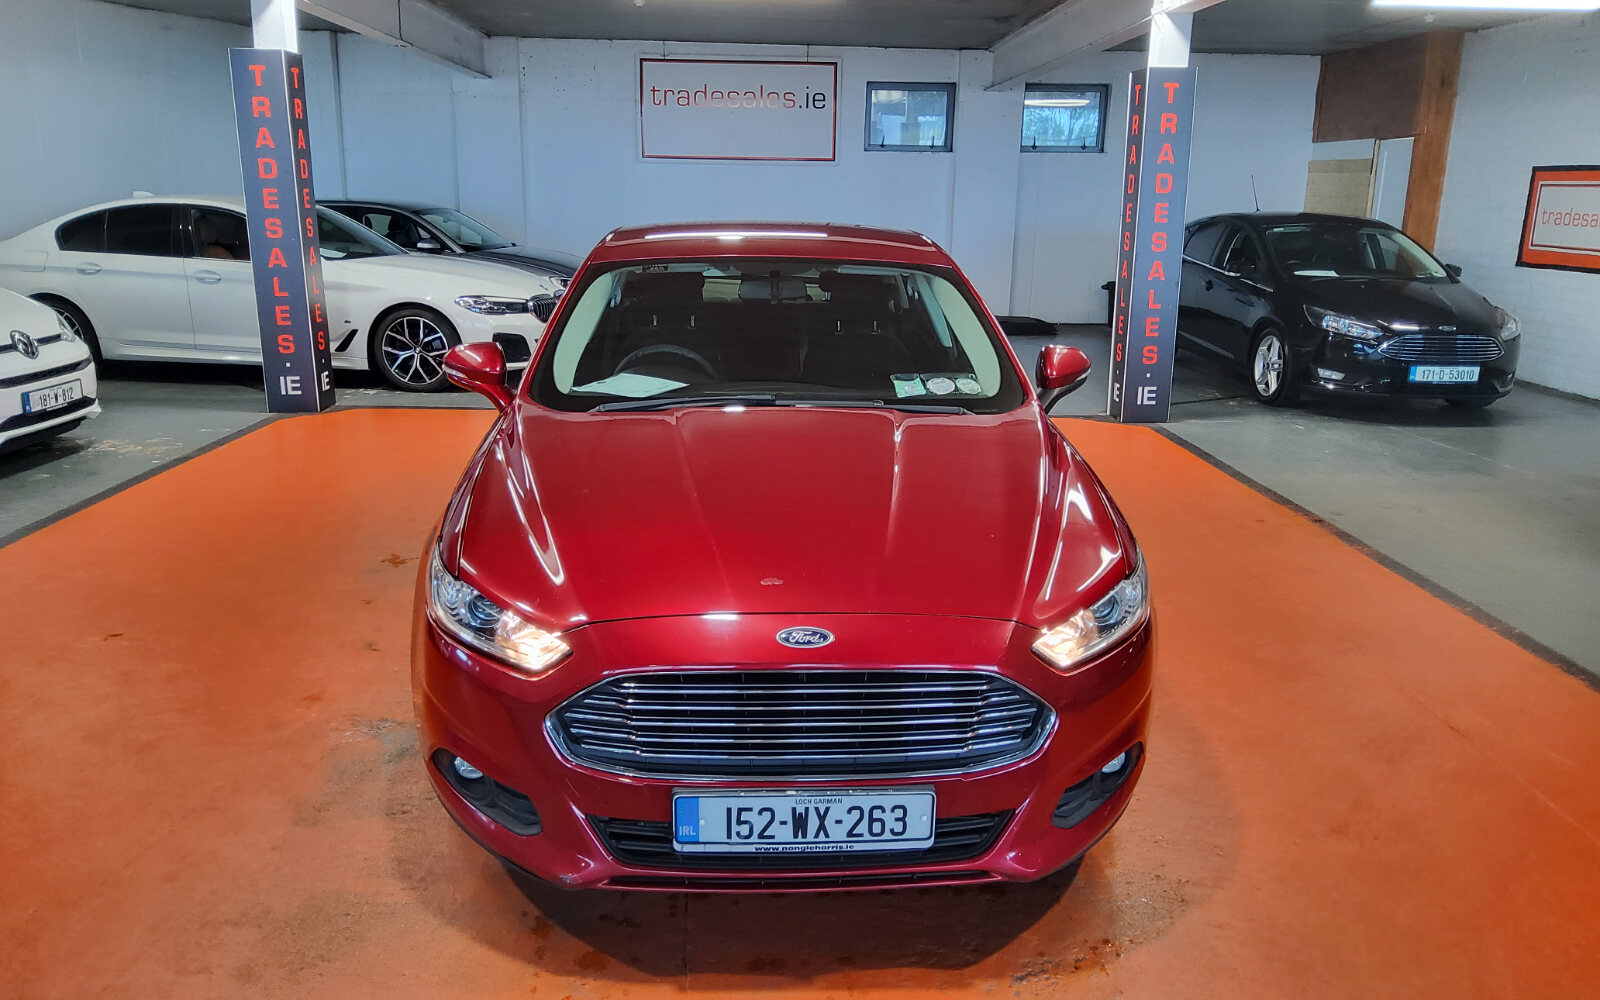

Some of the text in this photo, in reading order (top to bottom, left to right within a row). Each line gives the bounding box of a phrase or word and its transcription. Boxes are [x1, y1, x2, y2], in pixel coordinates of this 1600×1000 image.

[650, 84, 826, 109] tradesales.ie
[1541, 208, 1600, 228] tradesa
[1421, 369, 1475, 380] 171-D-53010
[39, 387, 74, 408] 181-W-812
[789, 631, 821, 643] Ford
[679, 825, 697, 836] IRL
[726, 804, 908, 840] 152-WX-263
